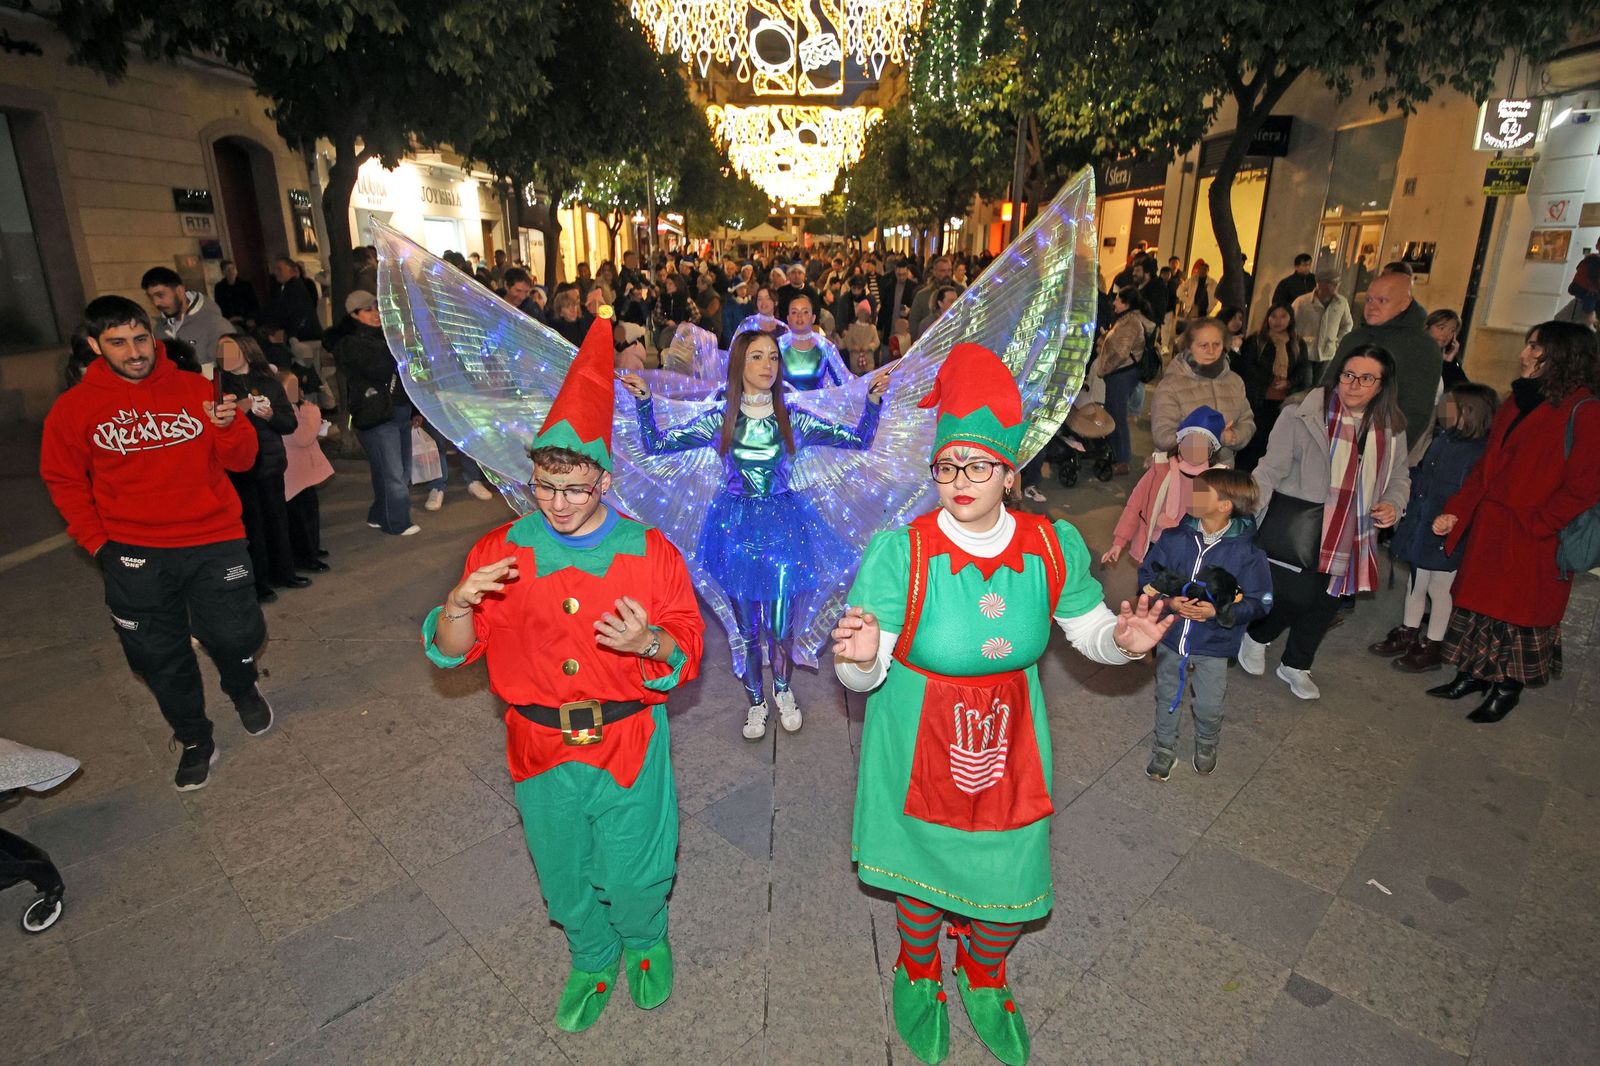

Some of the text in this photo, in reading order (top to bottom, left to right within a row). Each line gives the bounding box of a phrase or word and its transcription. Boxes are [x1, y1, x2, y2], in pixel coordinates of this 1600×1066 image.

[1136, 198, 1163, 207] Women
[1146, 207, 1162, 216] Men
[1144, 215, 1161, 225] Kids
